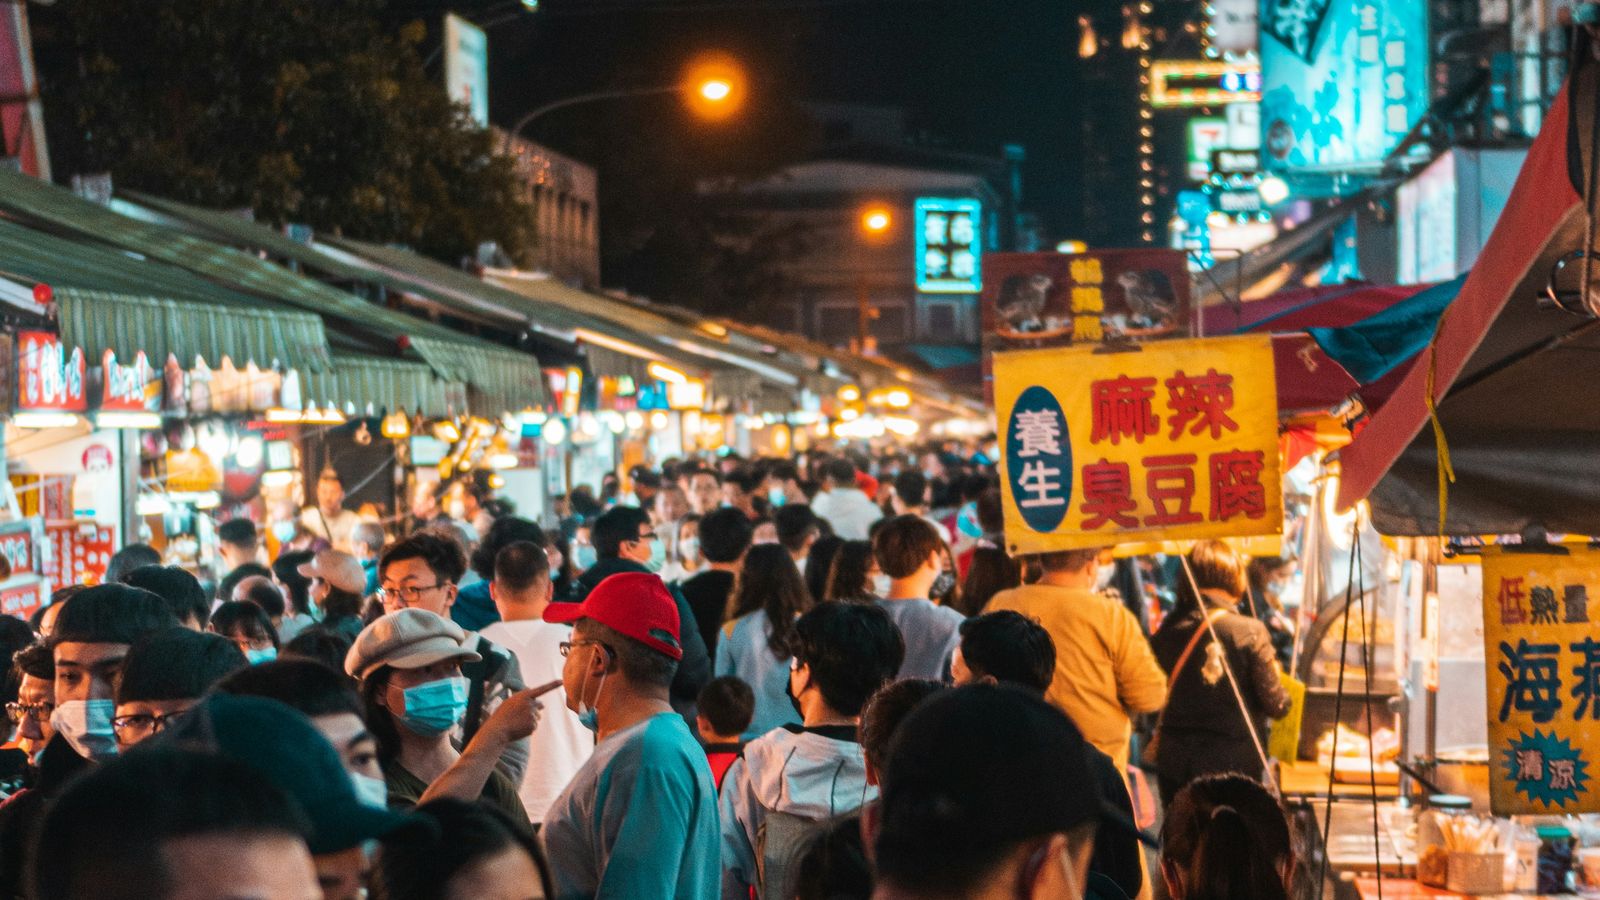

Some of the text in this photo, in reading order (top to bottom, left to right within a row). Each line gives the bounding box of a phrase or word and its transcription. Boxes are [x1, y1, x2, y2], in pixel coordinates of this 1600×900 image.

[1090, 368, 1239, 445] 麻辣
[1015, 408, 1065, 508] 養生
[1080, 448, 1266, 530] 臭豆腐
[1498, 576, 1588, 625] 低熱量
